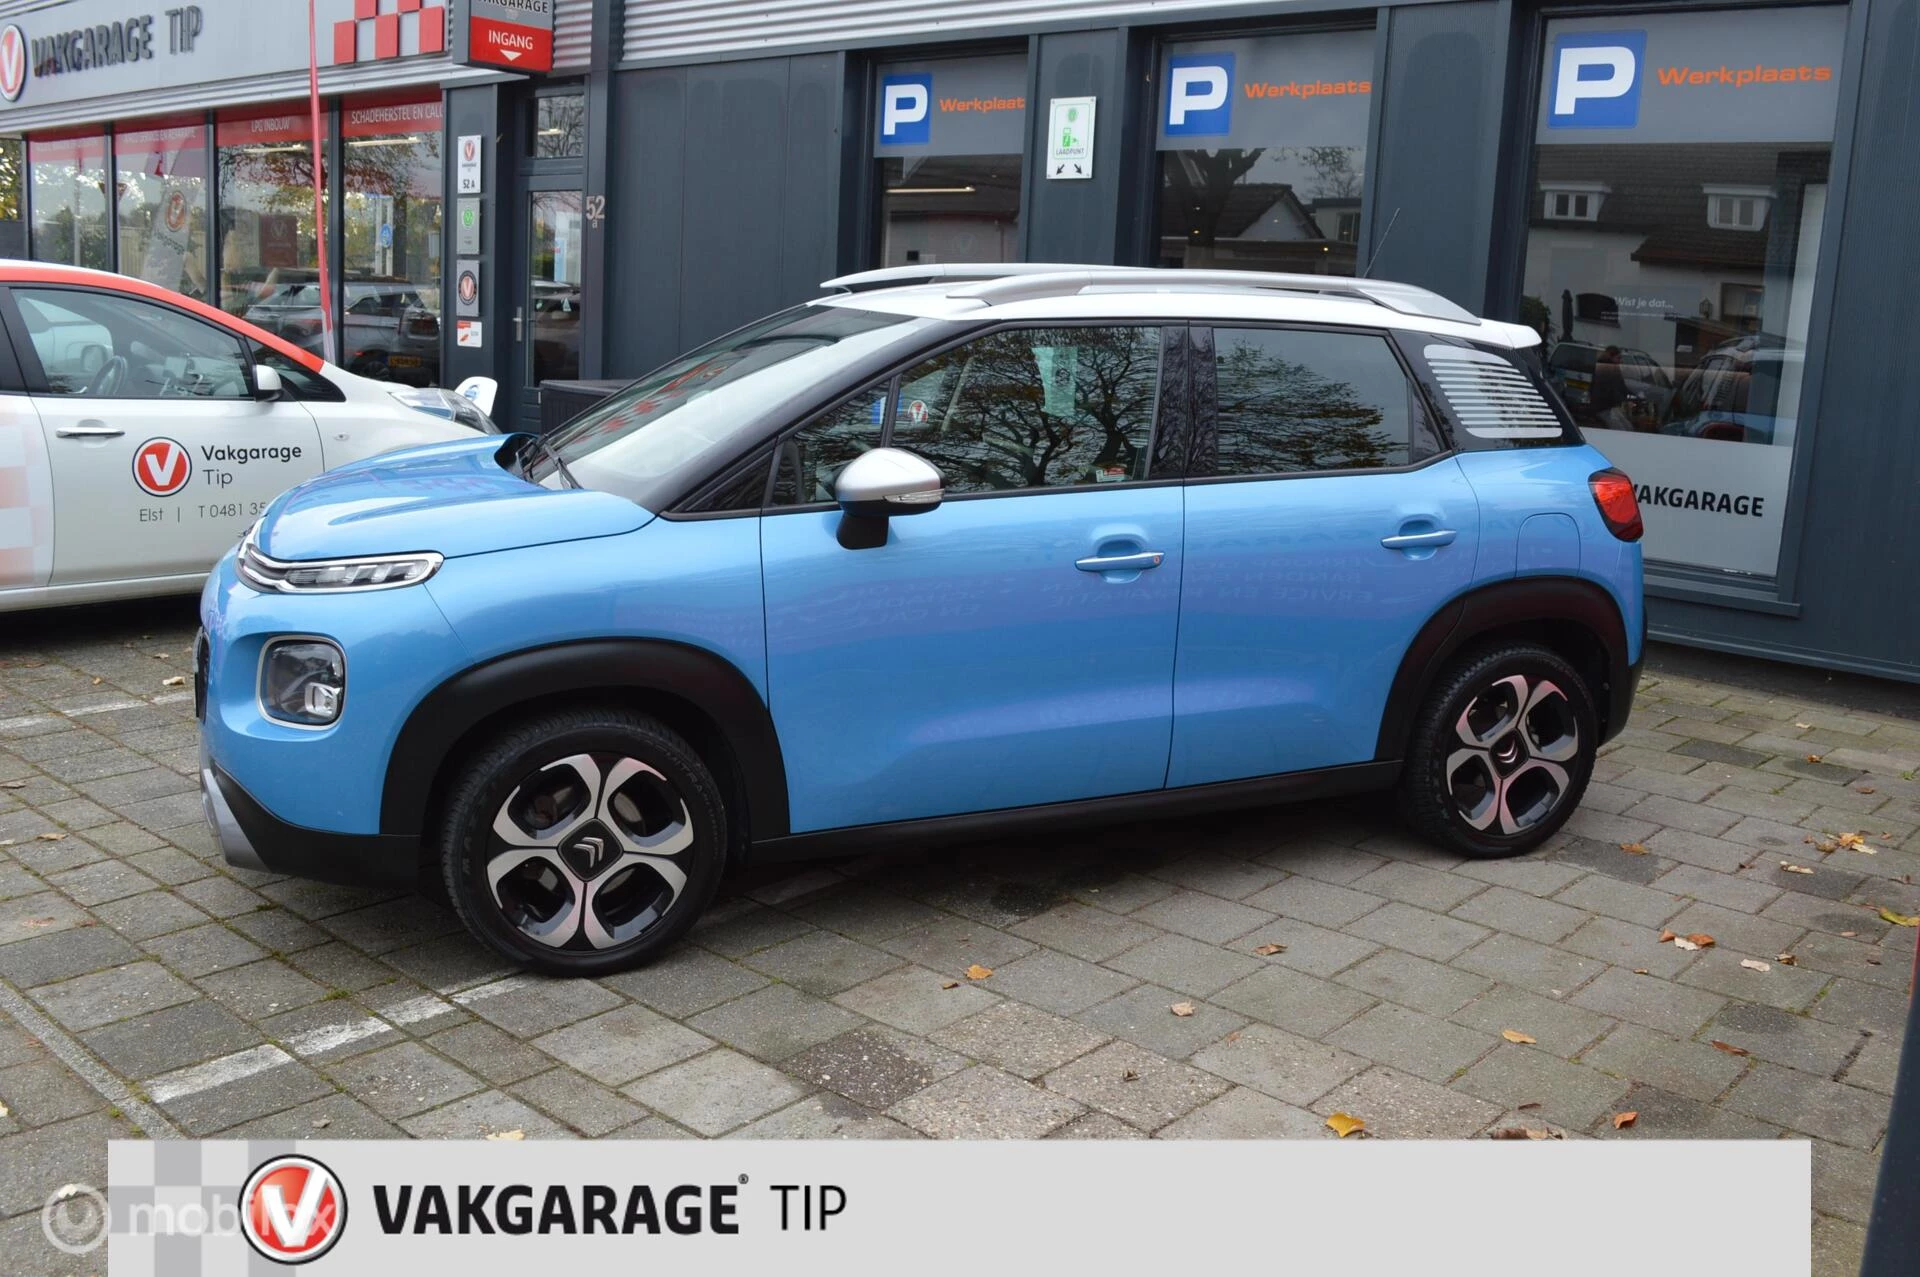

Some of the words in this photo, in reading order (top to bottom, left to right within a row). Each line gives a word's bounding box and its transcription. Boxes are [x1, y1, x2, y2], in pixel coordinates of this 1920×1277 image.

[31, 15, 154, 77] VAKGARAGE
[164, 5, 202, 54] TIP
[488, 29, 533, 50] INGANG
[1657, 64, 1833, 88] Werkplaats
[1243, 79, 1373, 99] Werkplaats
[351, 106, 411, 124] SCHADEHERSTEL
[413, 105, 424, 121] EN
[586, 194, 605, 220] 52
[201, 444, 302, 464] Vakgarage
[202, 468, 233, 488] Tip
[139, 508, 164, 522] Elst
[199, 505, 205, 518] T
[209, 503, 243, 518] 0481
